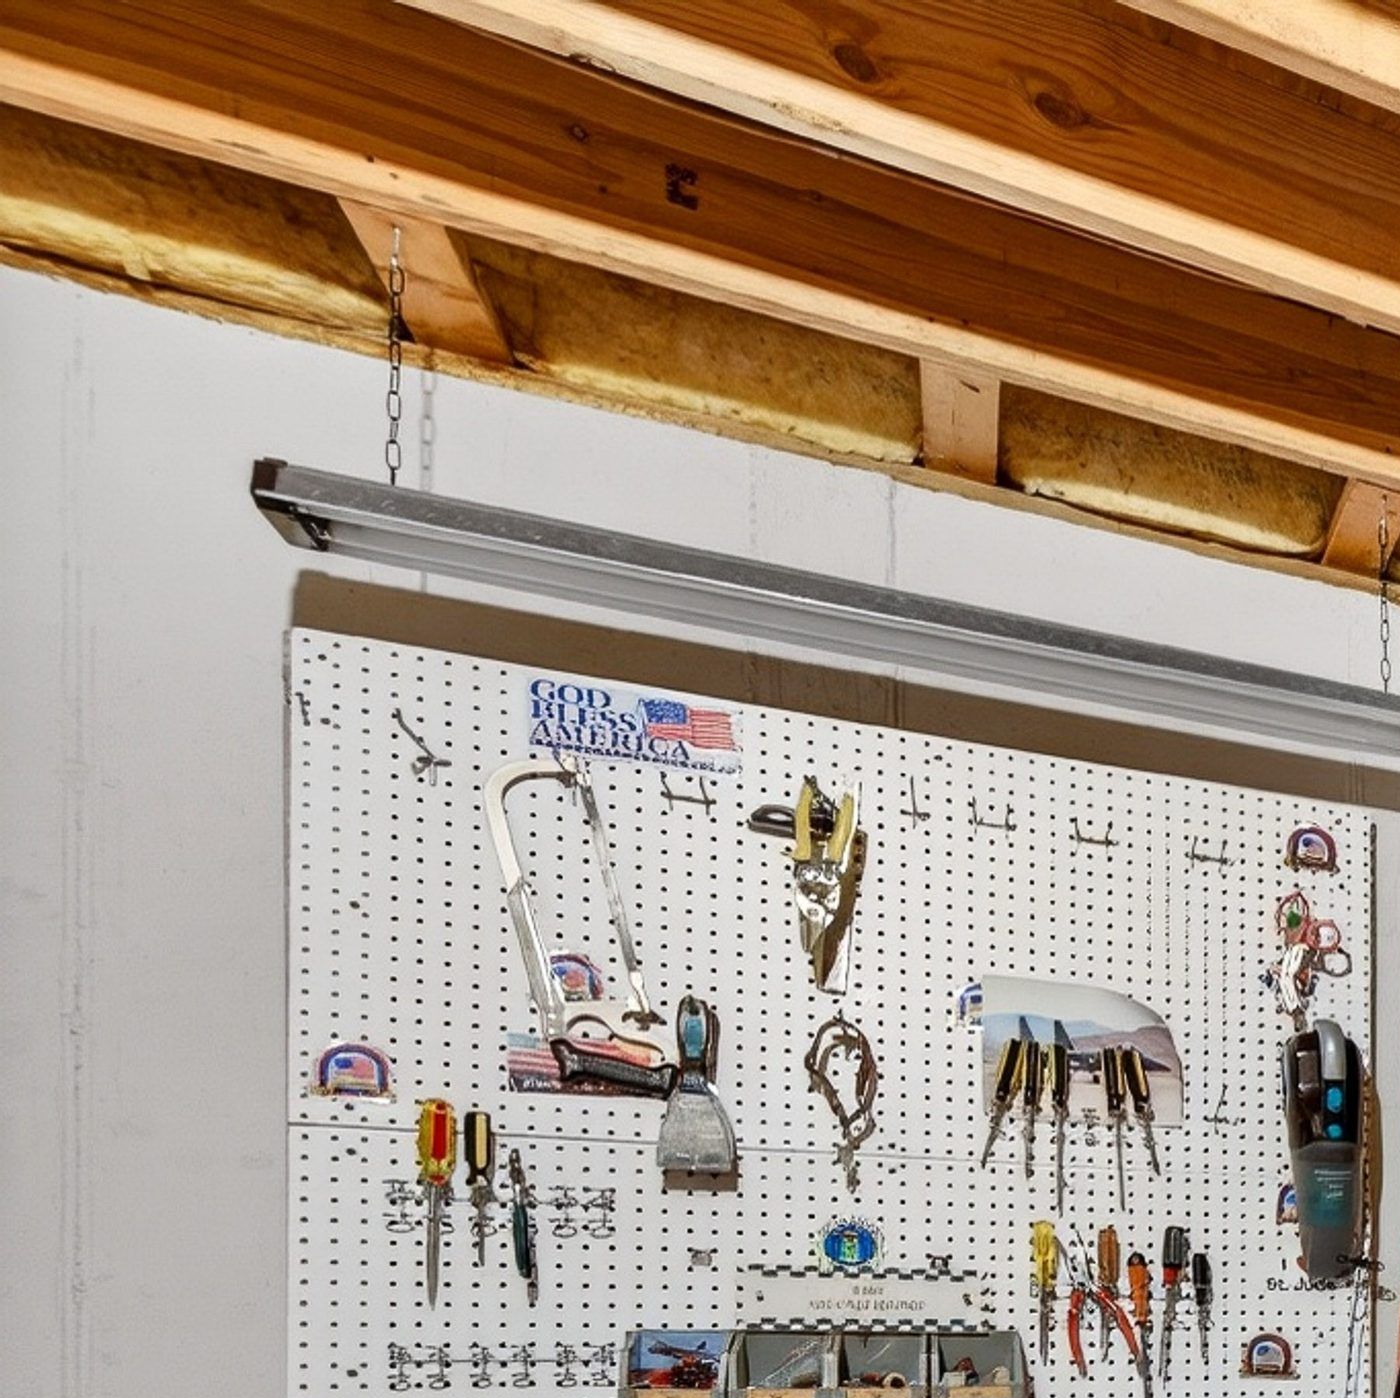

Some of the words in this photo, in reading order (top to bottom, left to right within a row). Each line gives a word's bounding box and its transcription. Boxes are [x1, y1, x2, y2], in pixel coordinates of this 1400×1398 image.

[530, 678, 612, 710] GOD
[531, 700, 638, 732] BLESS
[529, 719, 690, 761] AMERICA
